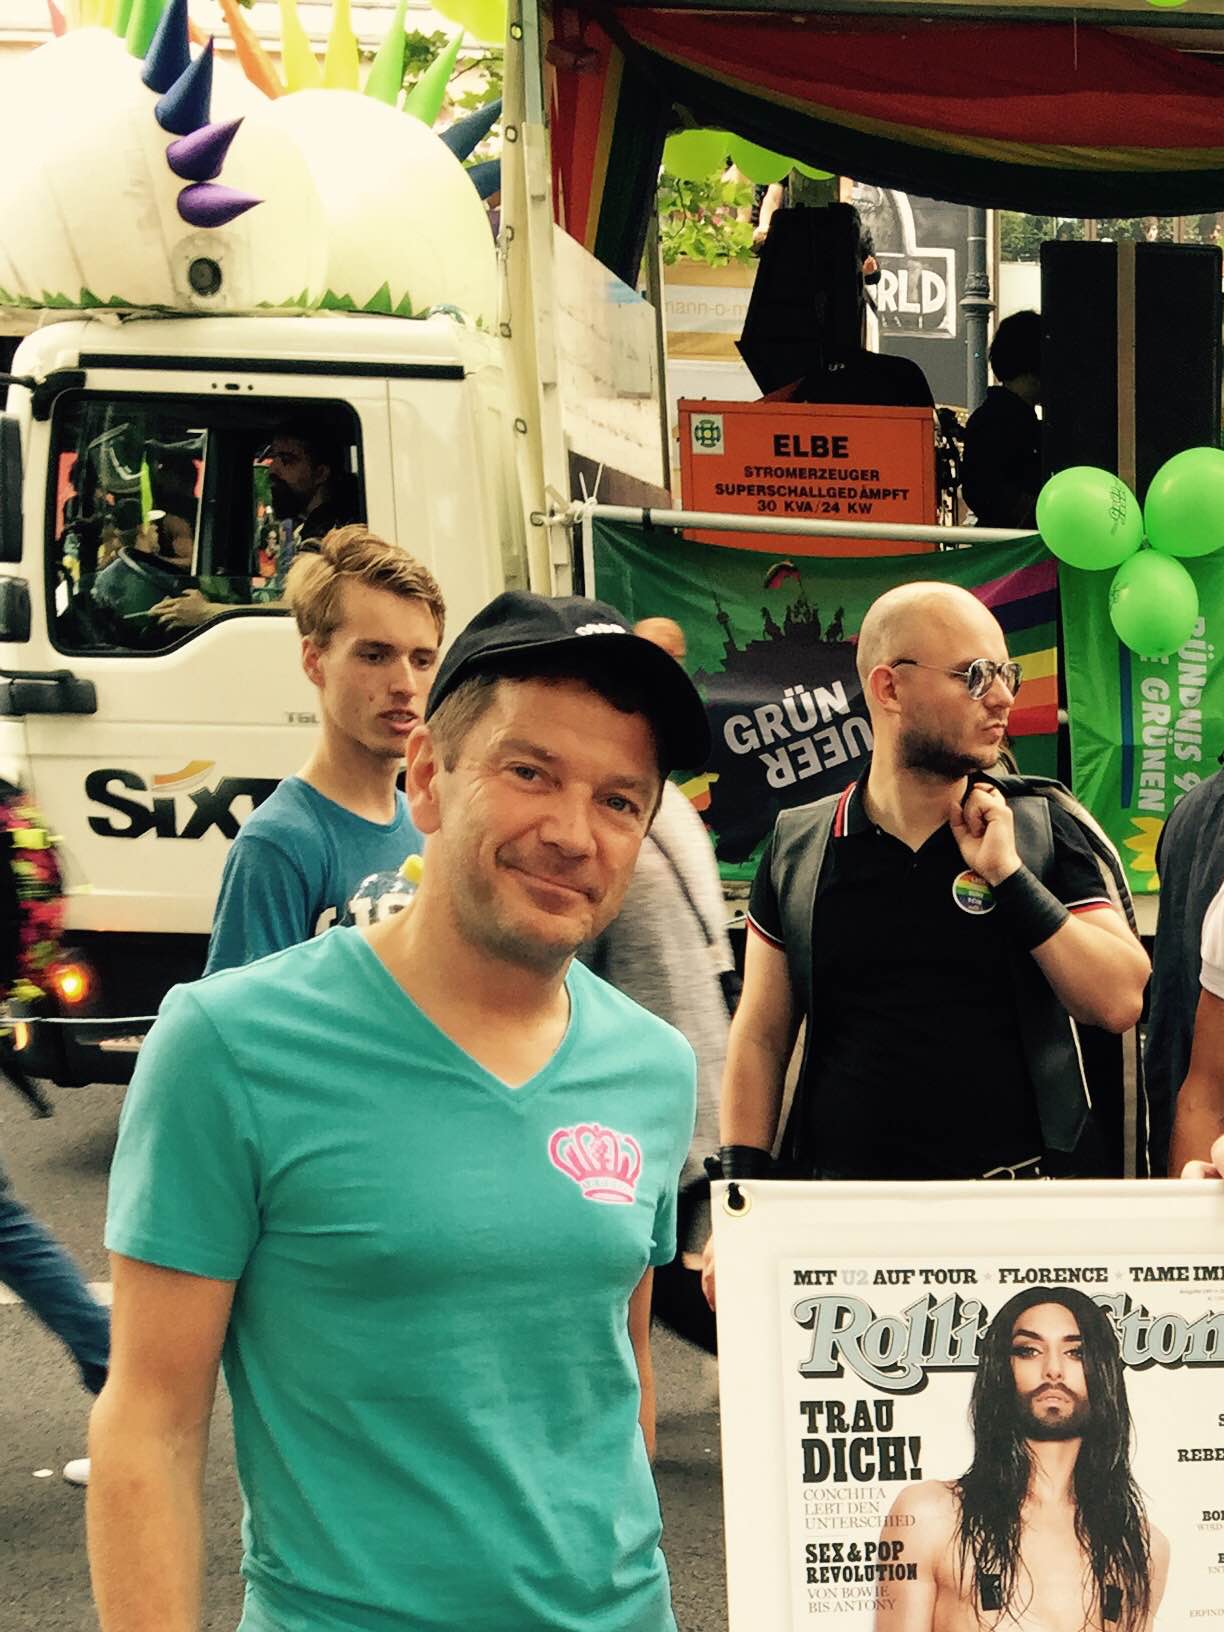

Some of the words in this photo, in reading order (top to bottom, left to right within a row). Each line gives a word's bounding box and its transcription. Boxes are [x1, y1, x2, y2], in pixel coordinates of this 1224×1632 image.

[865, 269, 946, 314] RLD
[773, 434, 849, 458] ELBE
[744, 465, 880, 482] STROMERZEUGER
[758, 500, 777, 512] 30
[848, 503, 872, 514] KW
[723, 680, 850, 755] GRÜN
[759, 716, 873, 788] UEER
[1137, 677, 1174, 812] GRÜNEN
[793, 1270, 837, 1286] MIT
[842, 1269, 868, 1285] U2
[873, 1269, 915, 1285] AUF
[919, 1268, 978, 1284] TOUR
[998, 1267, 1108, 1284] FLORENCE
[1129, 1267, 1189, 1282] TAME
[793, 1292, 988, 1394] Rolli
[800, 1399, 894, 1433] TRAU
[801, 1436, 922, 1483] DICH!
[803, 1487, 886, 1501] CONCHITA
[805, 1502, 844, 1516] LEBT
[848, 1501, 881, 1515] DEN
[805, 1514, 916, 1529] UNTERSCHIED
[806, 1563, 918, 1584] REVOLUTION
[808, 1587, 838, 1599] VON
[842, 1585, 890, 1598] BOWIE
[809, 1601, 831, 1613] BIS
[834, 1599, 897, 1612] ANTONY
